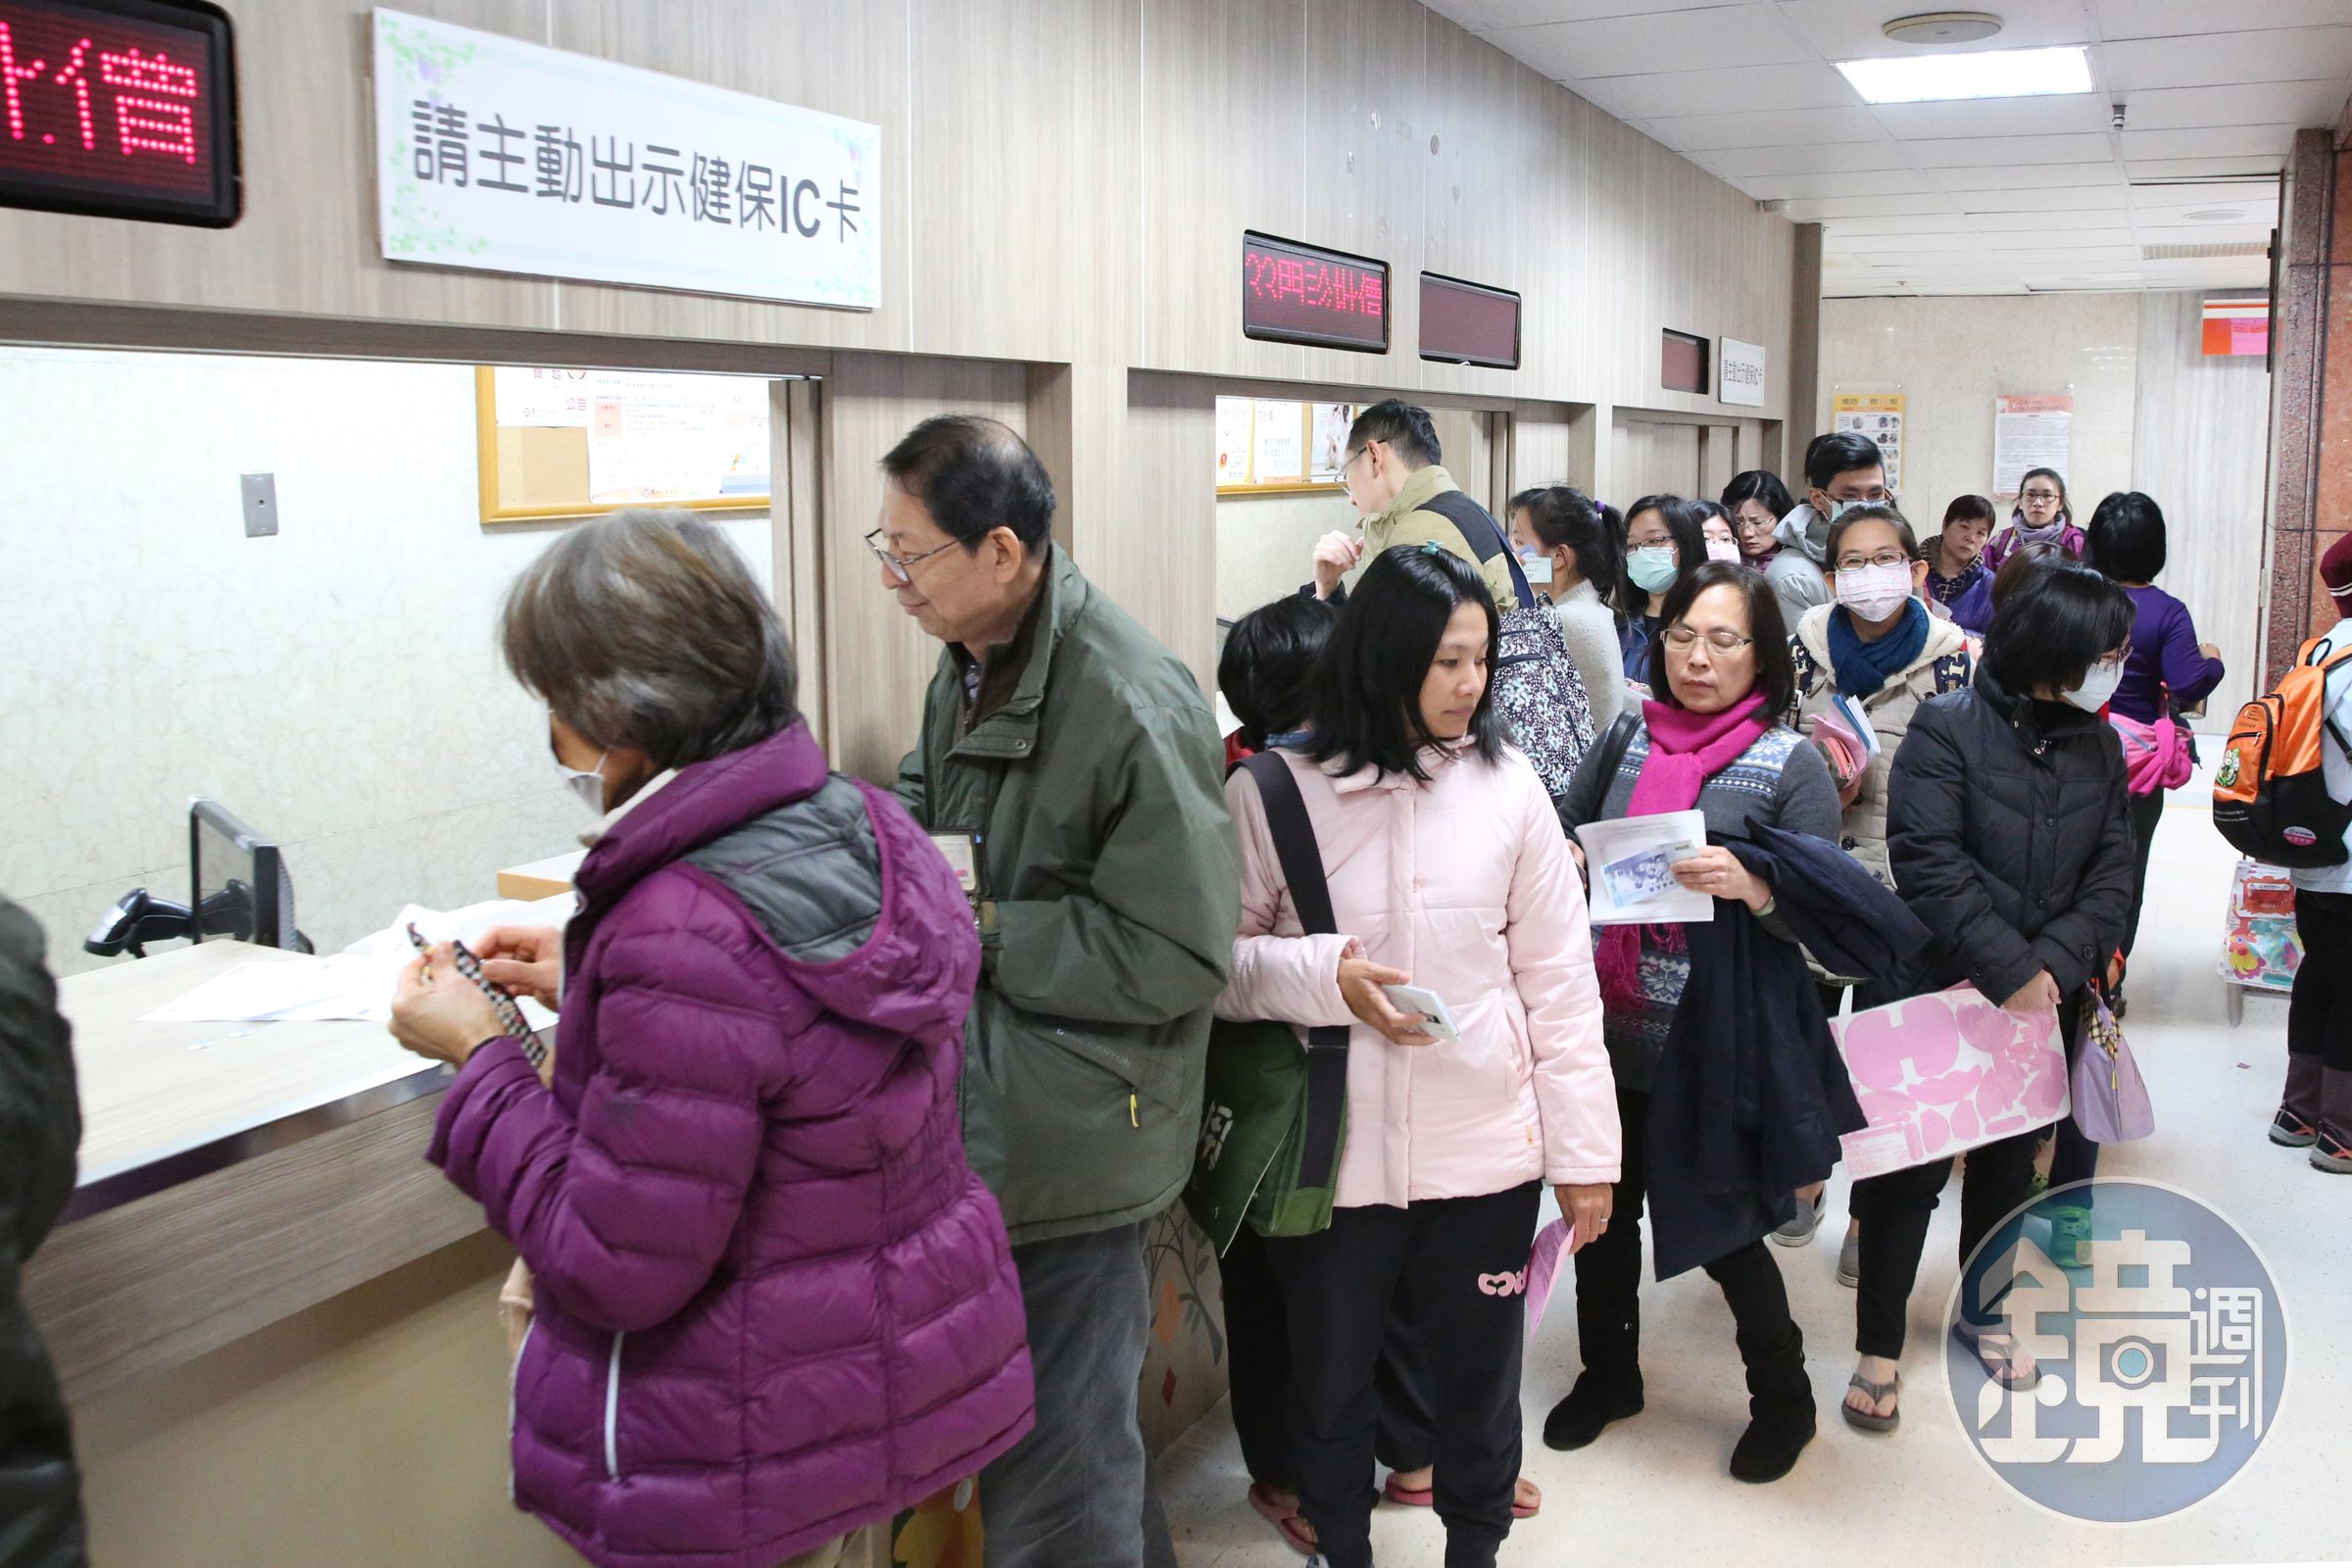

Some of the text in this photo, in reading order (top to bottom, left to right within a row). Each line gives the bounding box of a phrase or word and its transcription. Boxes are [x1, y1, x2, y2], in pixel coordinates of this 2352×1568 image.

[412, 99, 860, 244] 請主動出示健保IC卡
